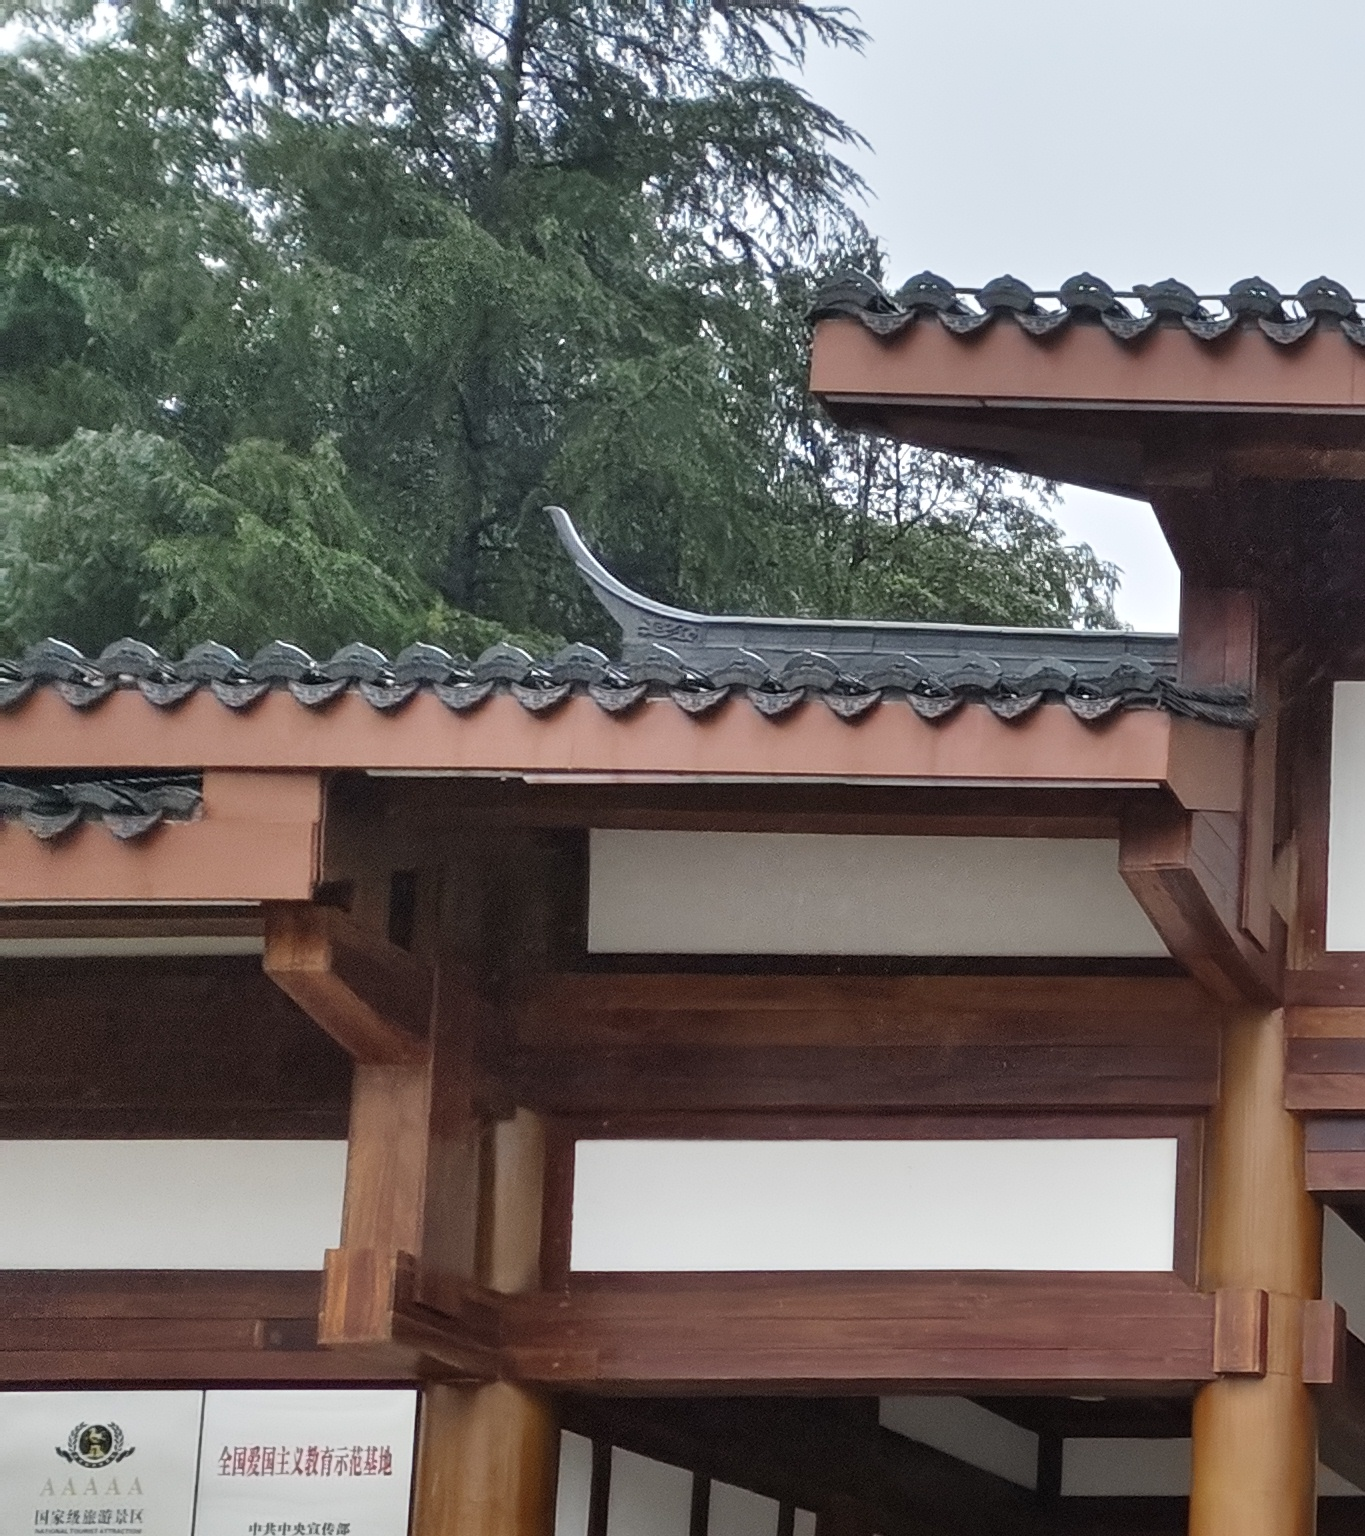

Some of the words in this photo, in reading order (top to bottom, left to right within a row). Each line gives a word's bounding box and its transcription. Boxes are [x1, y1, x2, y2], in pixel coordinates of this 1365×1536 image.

[217, 1445, 393, 1477] 全国爱国主义教育示范基地
[34, 1508, 144, 1525] 国家级旅游景区
[249, 1521, 351, 1536] 中共中央宣传部
